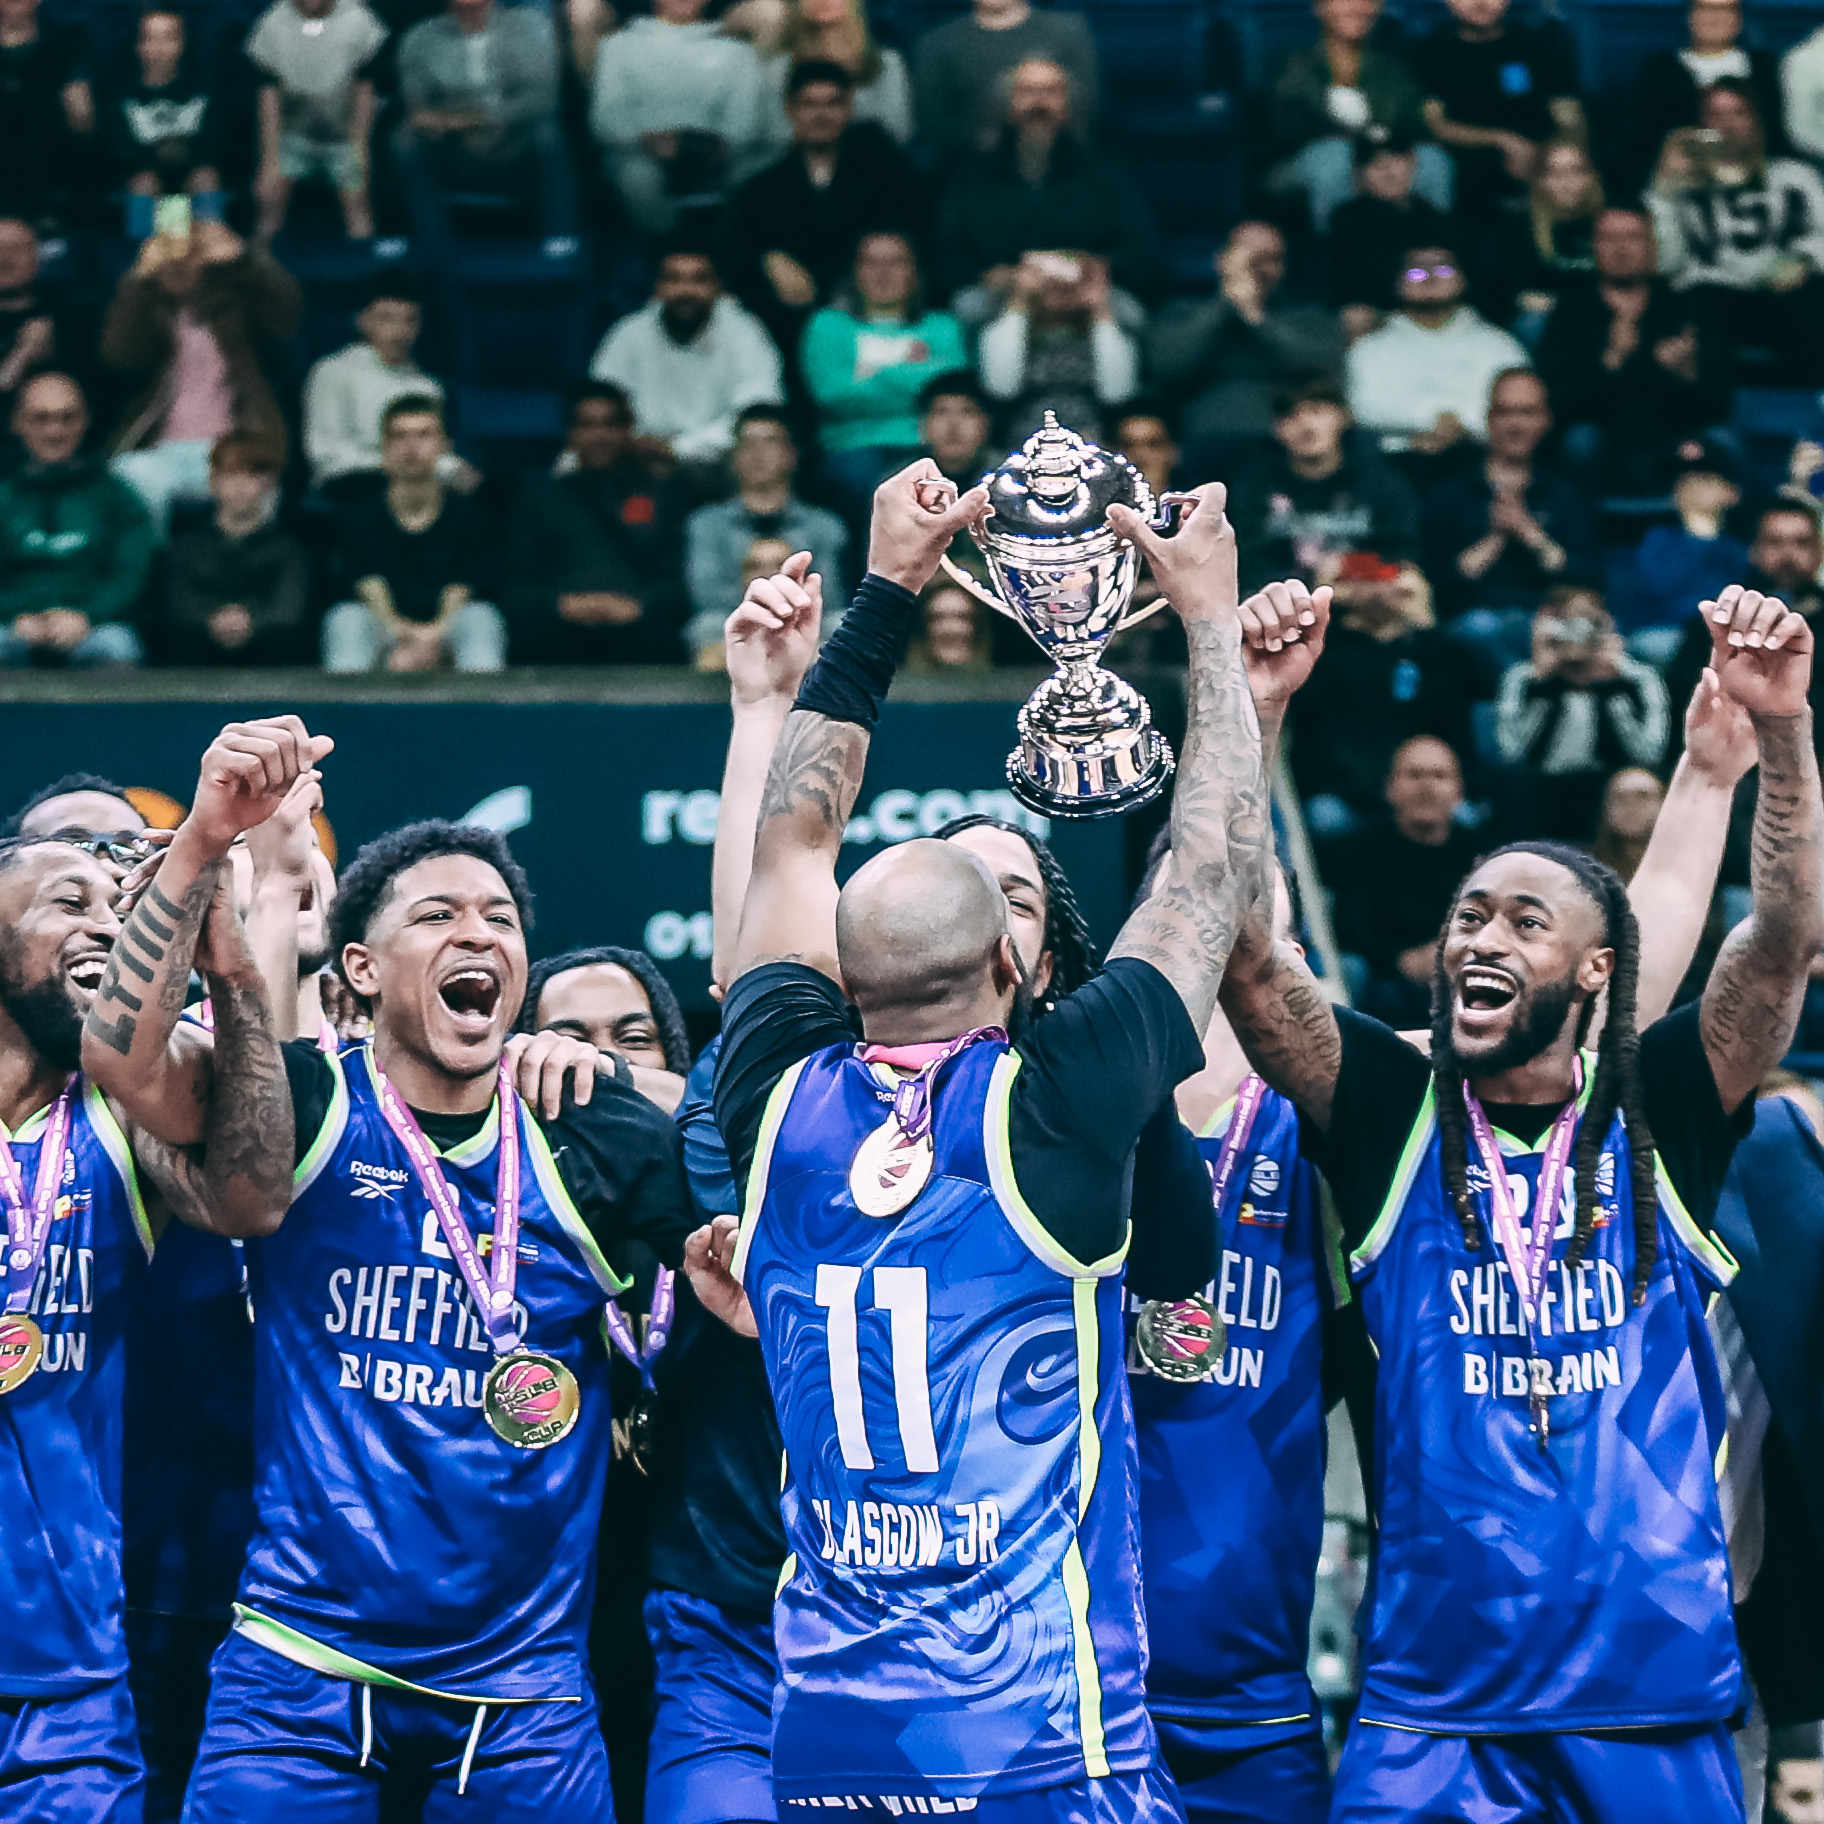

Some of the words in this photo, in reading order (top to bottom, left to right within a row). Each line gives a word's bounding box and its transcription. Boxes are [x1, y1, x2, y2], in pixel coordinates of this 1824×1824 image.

[349, 1160, 409, 1183] Reebok
[373, 1359, 492, 1408] BRAU
[814, 1263, 941, 1473] 11
[955, 1499, 1001, 1567] JR
